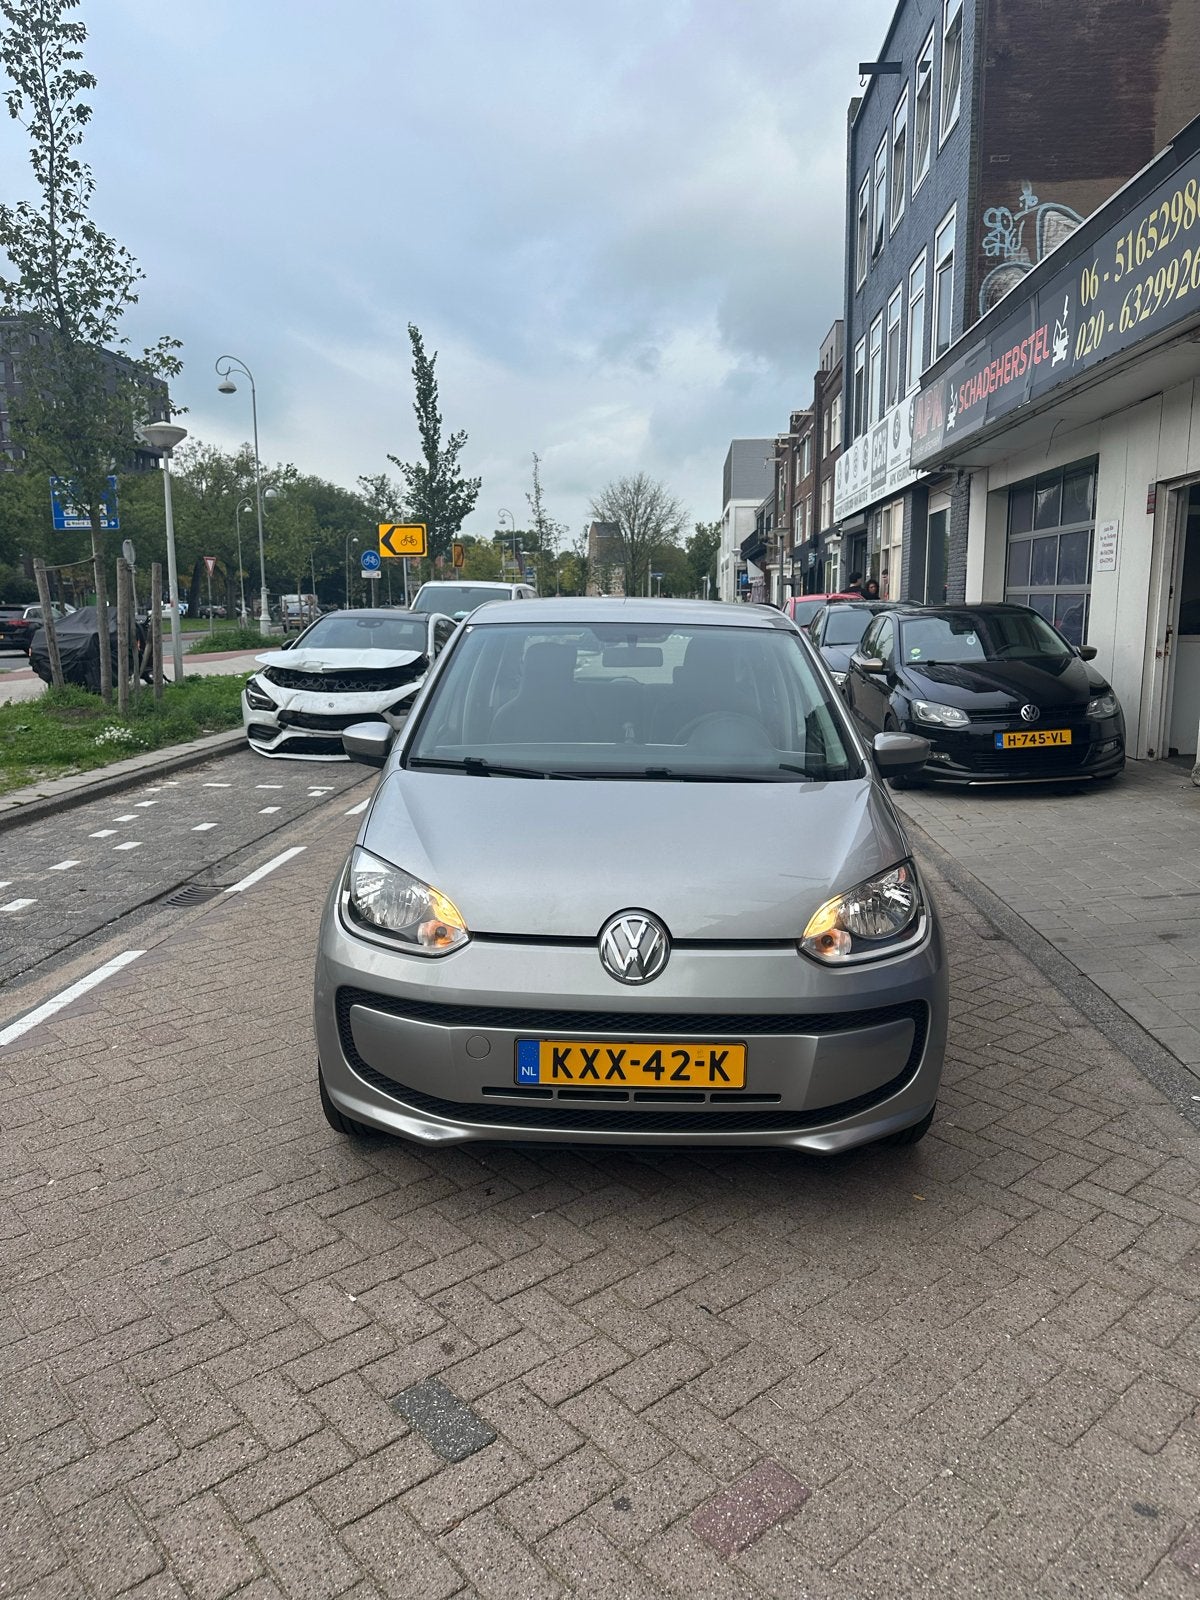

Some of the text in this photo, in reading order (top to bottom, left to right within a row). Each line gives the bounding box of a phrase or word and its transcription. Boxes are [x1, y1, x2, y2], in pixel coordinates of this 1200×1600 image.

[1080, 258, 1099, 307] 06
[1114, 178, 1200, 283] 5165298
[1074, 309, 1105, 362] 020
[958, 323, 1050, 414] SCHADEHERSTEL
[913, 378, 945, 444] APK
[1008, 732, 1067, 746] H-745-VL
[521, 1047, 731, 1082] NL KXX-42-K
